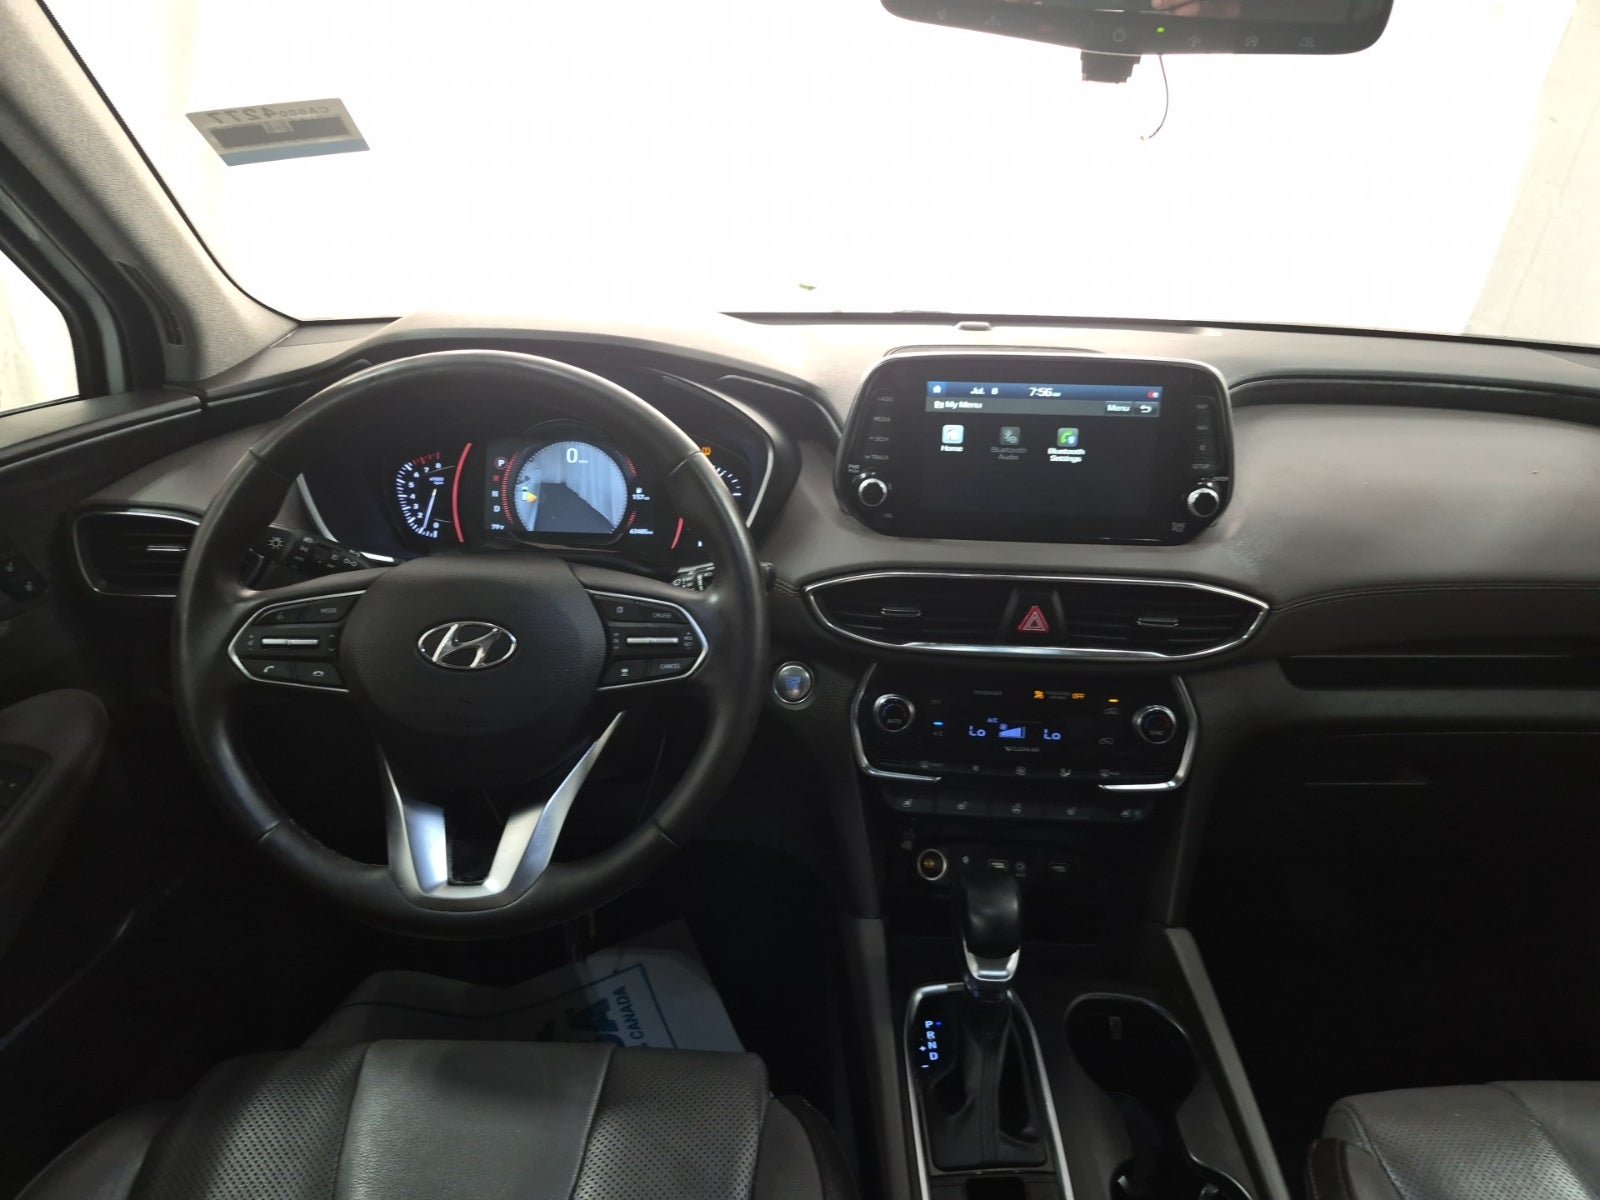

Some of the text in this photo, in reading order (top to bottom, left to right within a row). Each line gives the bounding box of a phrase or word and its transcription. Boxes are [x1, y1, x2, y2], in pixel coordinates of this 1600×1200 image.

[613, 985, 645, 1040] CANADA
[924, 1020, 939, 1061] P R N D
